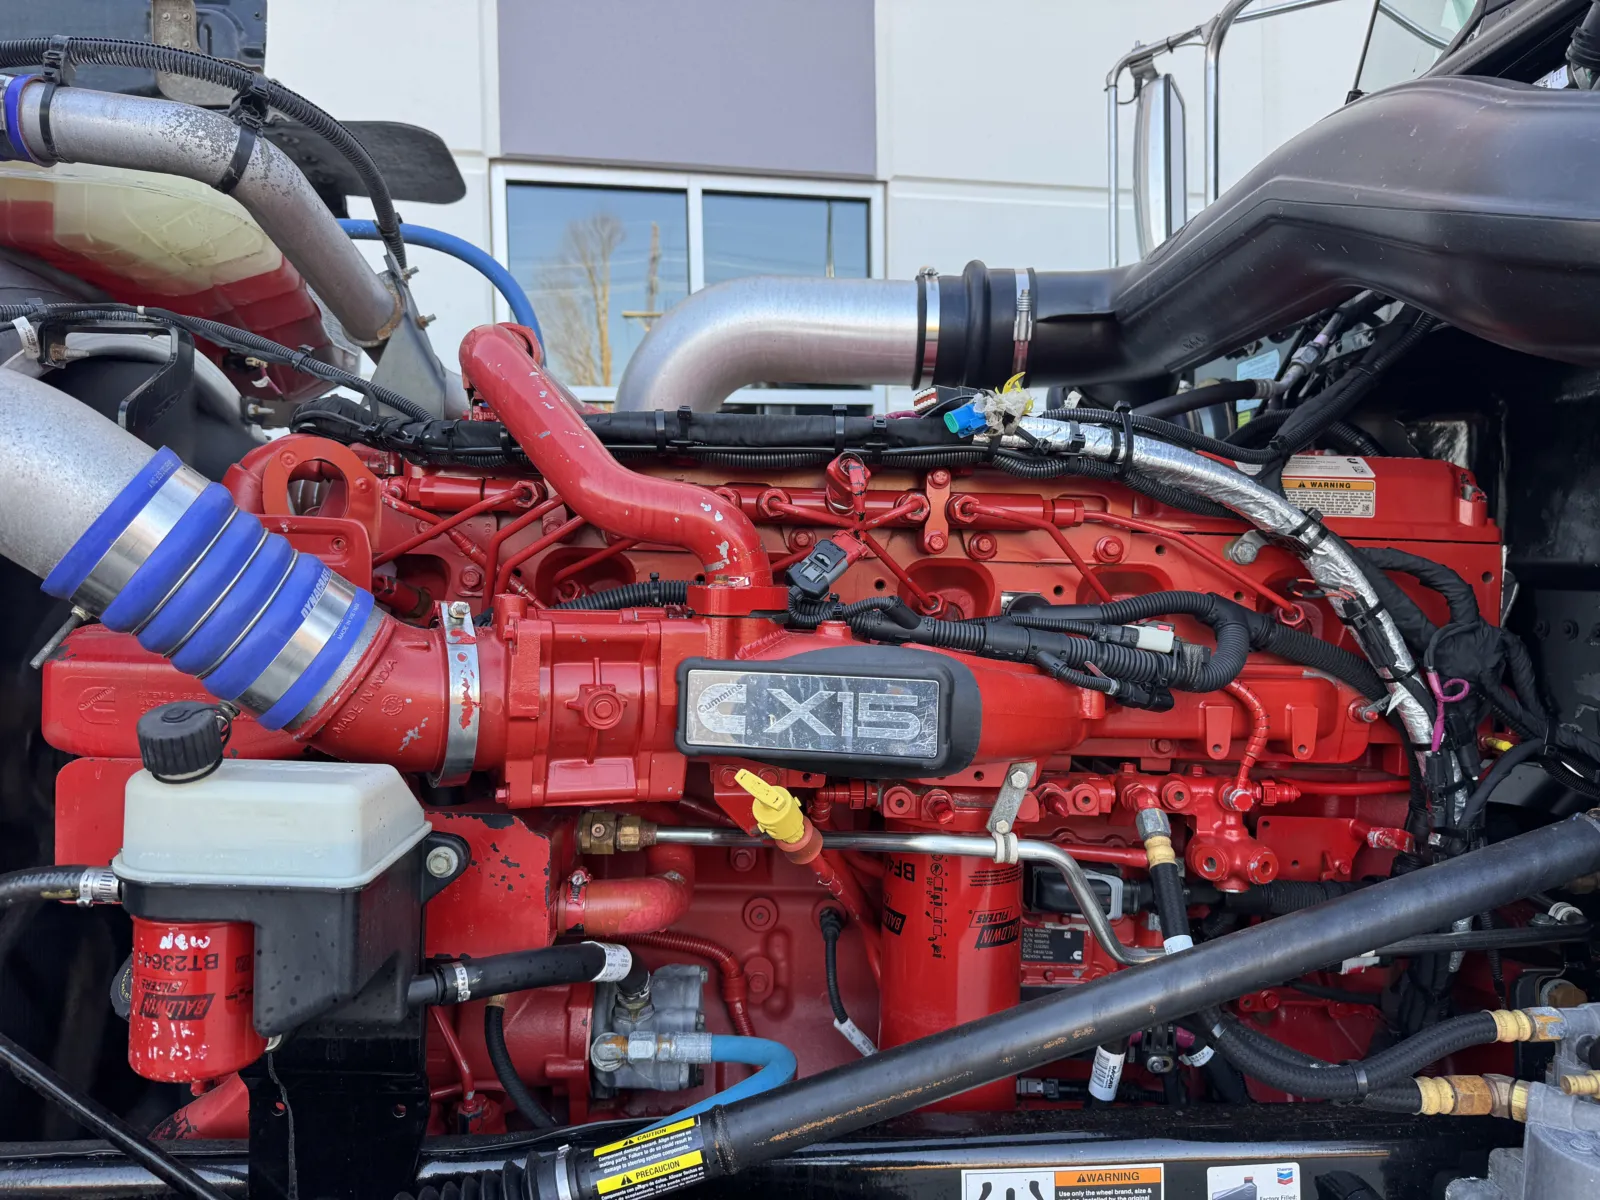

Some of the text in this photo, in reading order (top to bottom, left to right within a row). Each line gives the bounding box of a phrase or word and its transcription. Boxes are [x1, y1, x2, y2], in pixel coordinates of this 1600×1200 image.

[1310, 481, 1351, 489] WARNING
[333, 705, 363, 734] MADE
[360, 689, 374, 704] IN
[370, 660, 398, 691] INDIA
[698, 682, 743, 714] Cummins
[763, 688, 921, 740] X15
[976, 910, 1009, 925] FILTERS
[980, 918, 1020, 945] BALDWIN
[637, 1128, 667, 1141] CAUTION
[598, 1151, 623, 1163] Component
[623, 1145, 641, 1155] damage
[641, 1140, 658, 1149] hazard.
[658, 1136, 669, 1144] Align
[599, 1159, 615, 1169] mating
[615, 1155, 629, 1164] parts.
[628, 1151, 643, 1159] Failure
[661, 1141, 674, 1149] could
[603, 1165, 622, 1175] damage
[627, 1157, 646, 1168] steering
[645, 1152, 662, 1162] system
[662, 1143, 690, 1157] components.
[635, 1160, 680, 1180] PRECAUCION
[1086, 1171, 1139, 1183] WARNING
[601, 1189, 626, 1200] Componente
[1114, 1188, 1133, 1196] brand,
